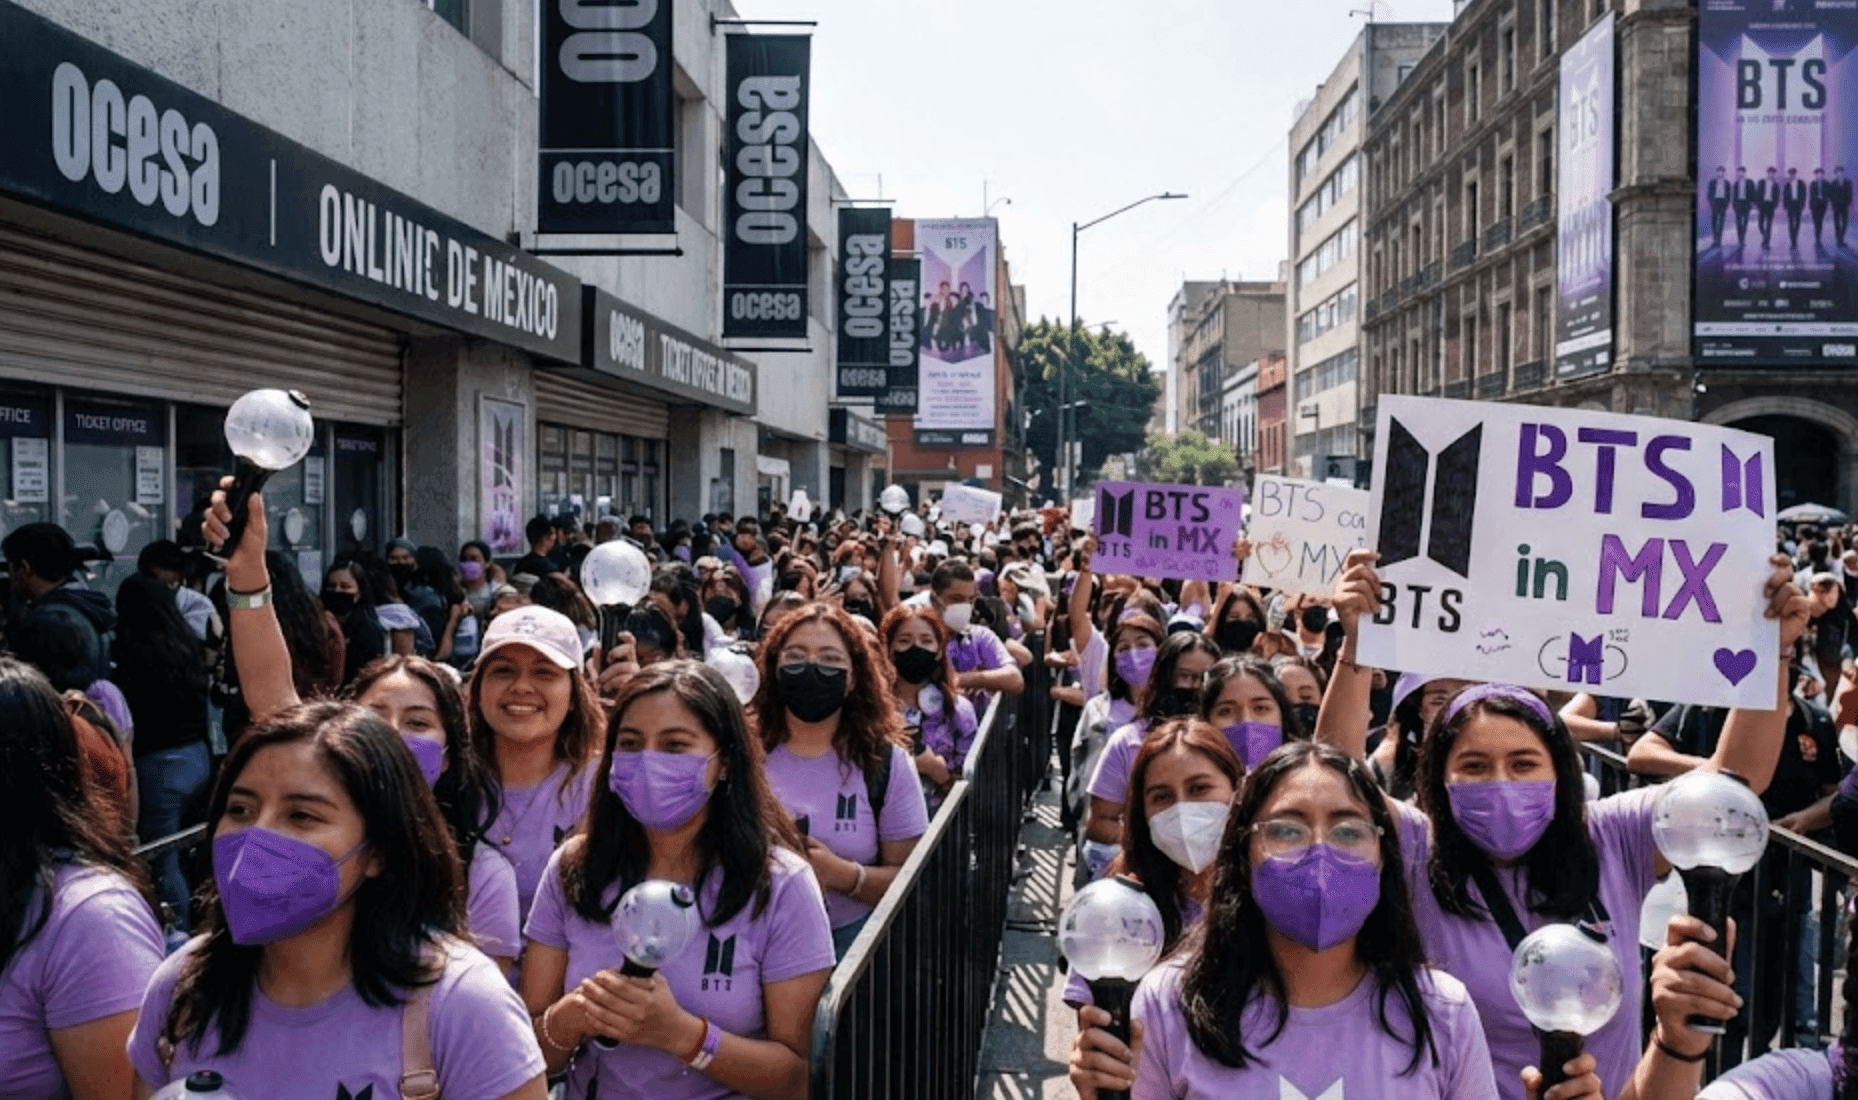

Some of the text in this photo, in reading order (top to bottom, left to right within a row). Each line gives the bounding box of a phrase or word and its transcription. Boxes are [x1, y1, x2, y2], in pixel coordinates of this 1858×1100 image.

[1737, 58, 1827, 110] BTS
[52, 61, 219, 227] ocesa
[736, 75, 801, 244] ocesa
[552, 161, 661, 204] ocesa
[447, 238, 479, 315] DE
[483, 254, 558, 341] MÉXICO
[731, 292, 801, 320] ocesa
[844, 233, 885, 338] ocesa
[1514, 423, 1696, 521] BTS
[1145, 490, 1210, 523] BTS
[1260, 480, 1325, 523] BTS
[1177, 525, 1221, 555] MX
[1298, 541, 1354, 585] MX
[1515, 533, 1729, 624] in MX
[1372, 581, 1464, 634] BTS
